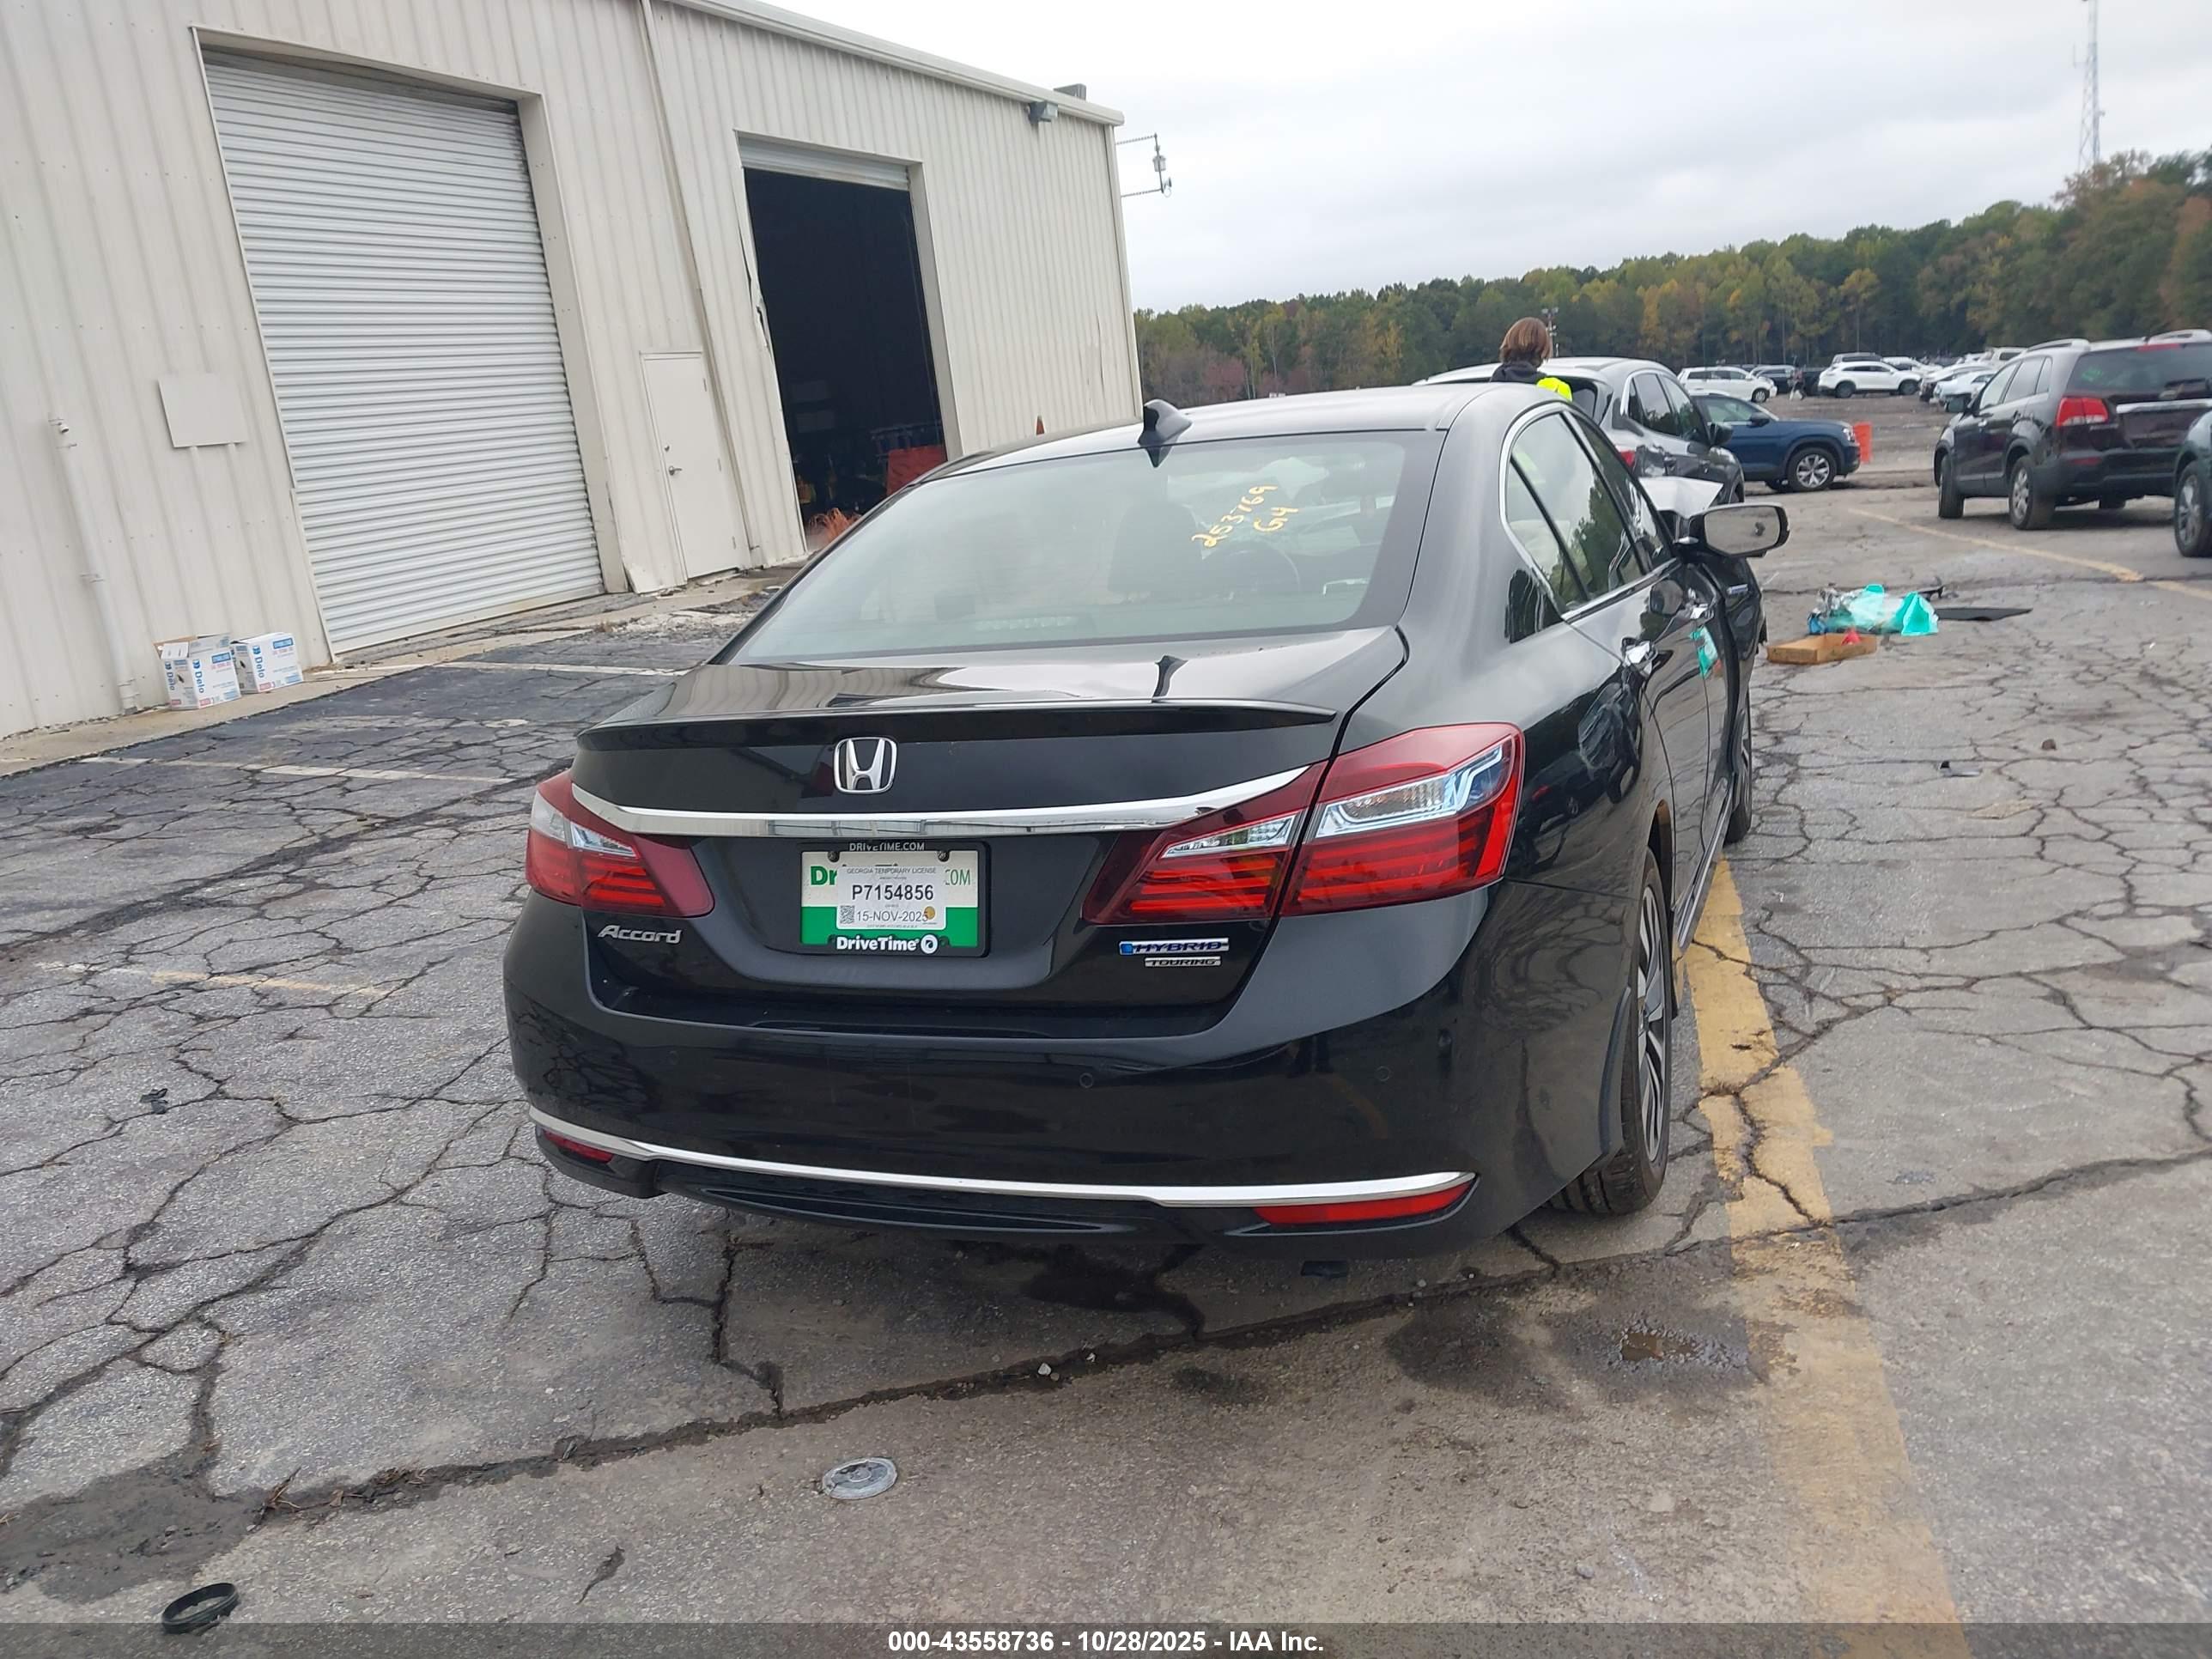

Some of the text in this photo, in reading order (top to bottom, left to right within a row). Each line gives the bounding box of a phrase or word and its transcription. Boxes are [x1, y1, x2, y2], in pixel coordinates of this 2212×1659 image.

[852, 884, 934, 901] P7154856
[597, 925, 682, 944] Accord
[836, 935, 921, 952] DriveTime
[1135, 941, 1223, 952] HYBRID
